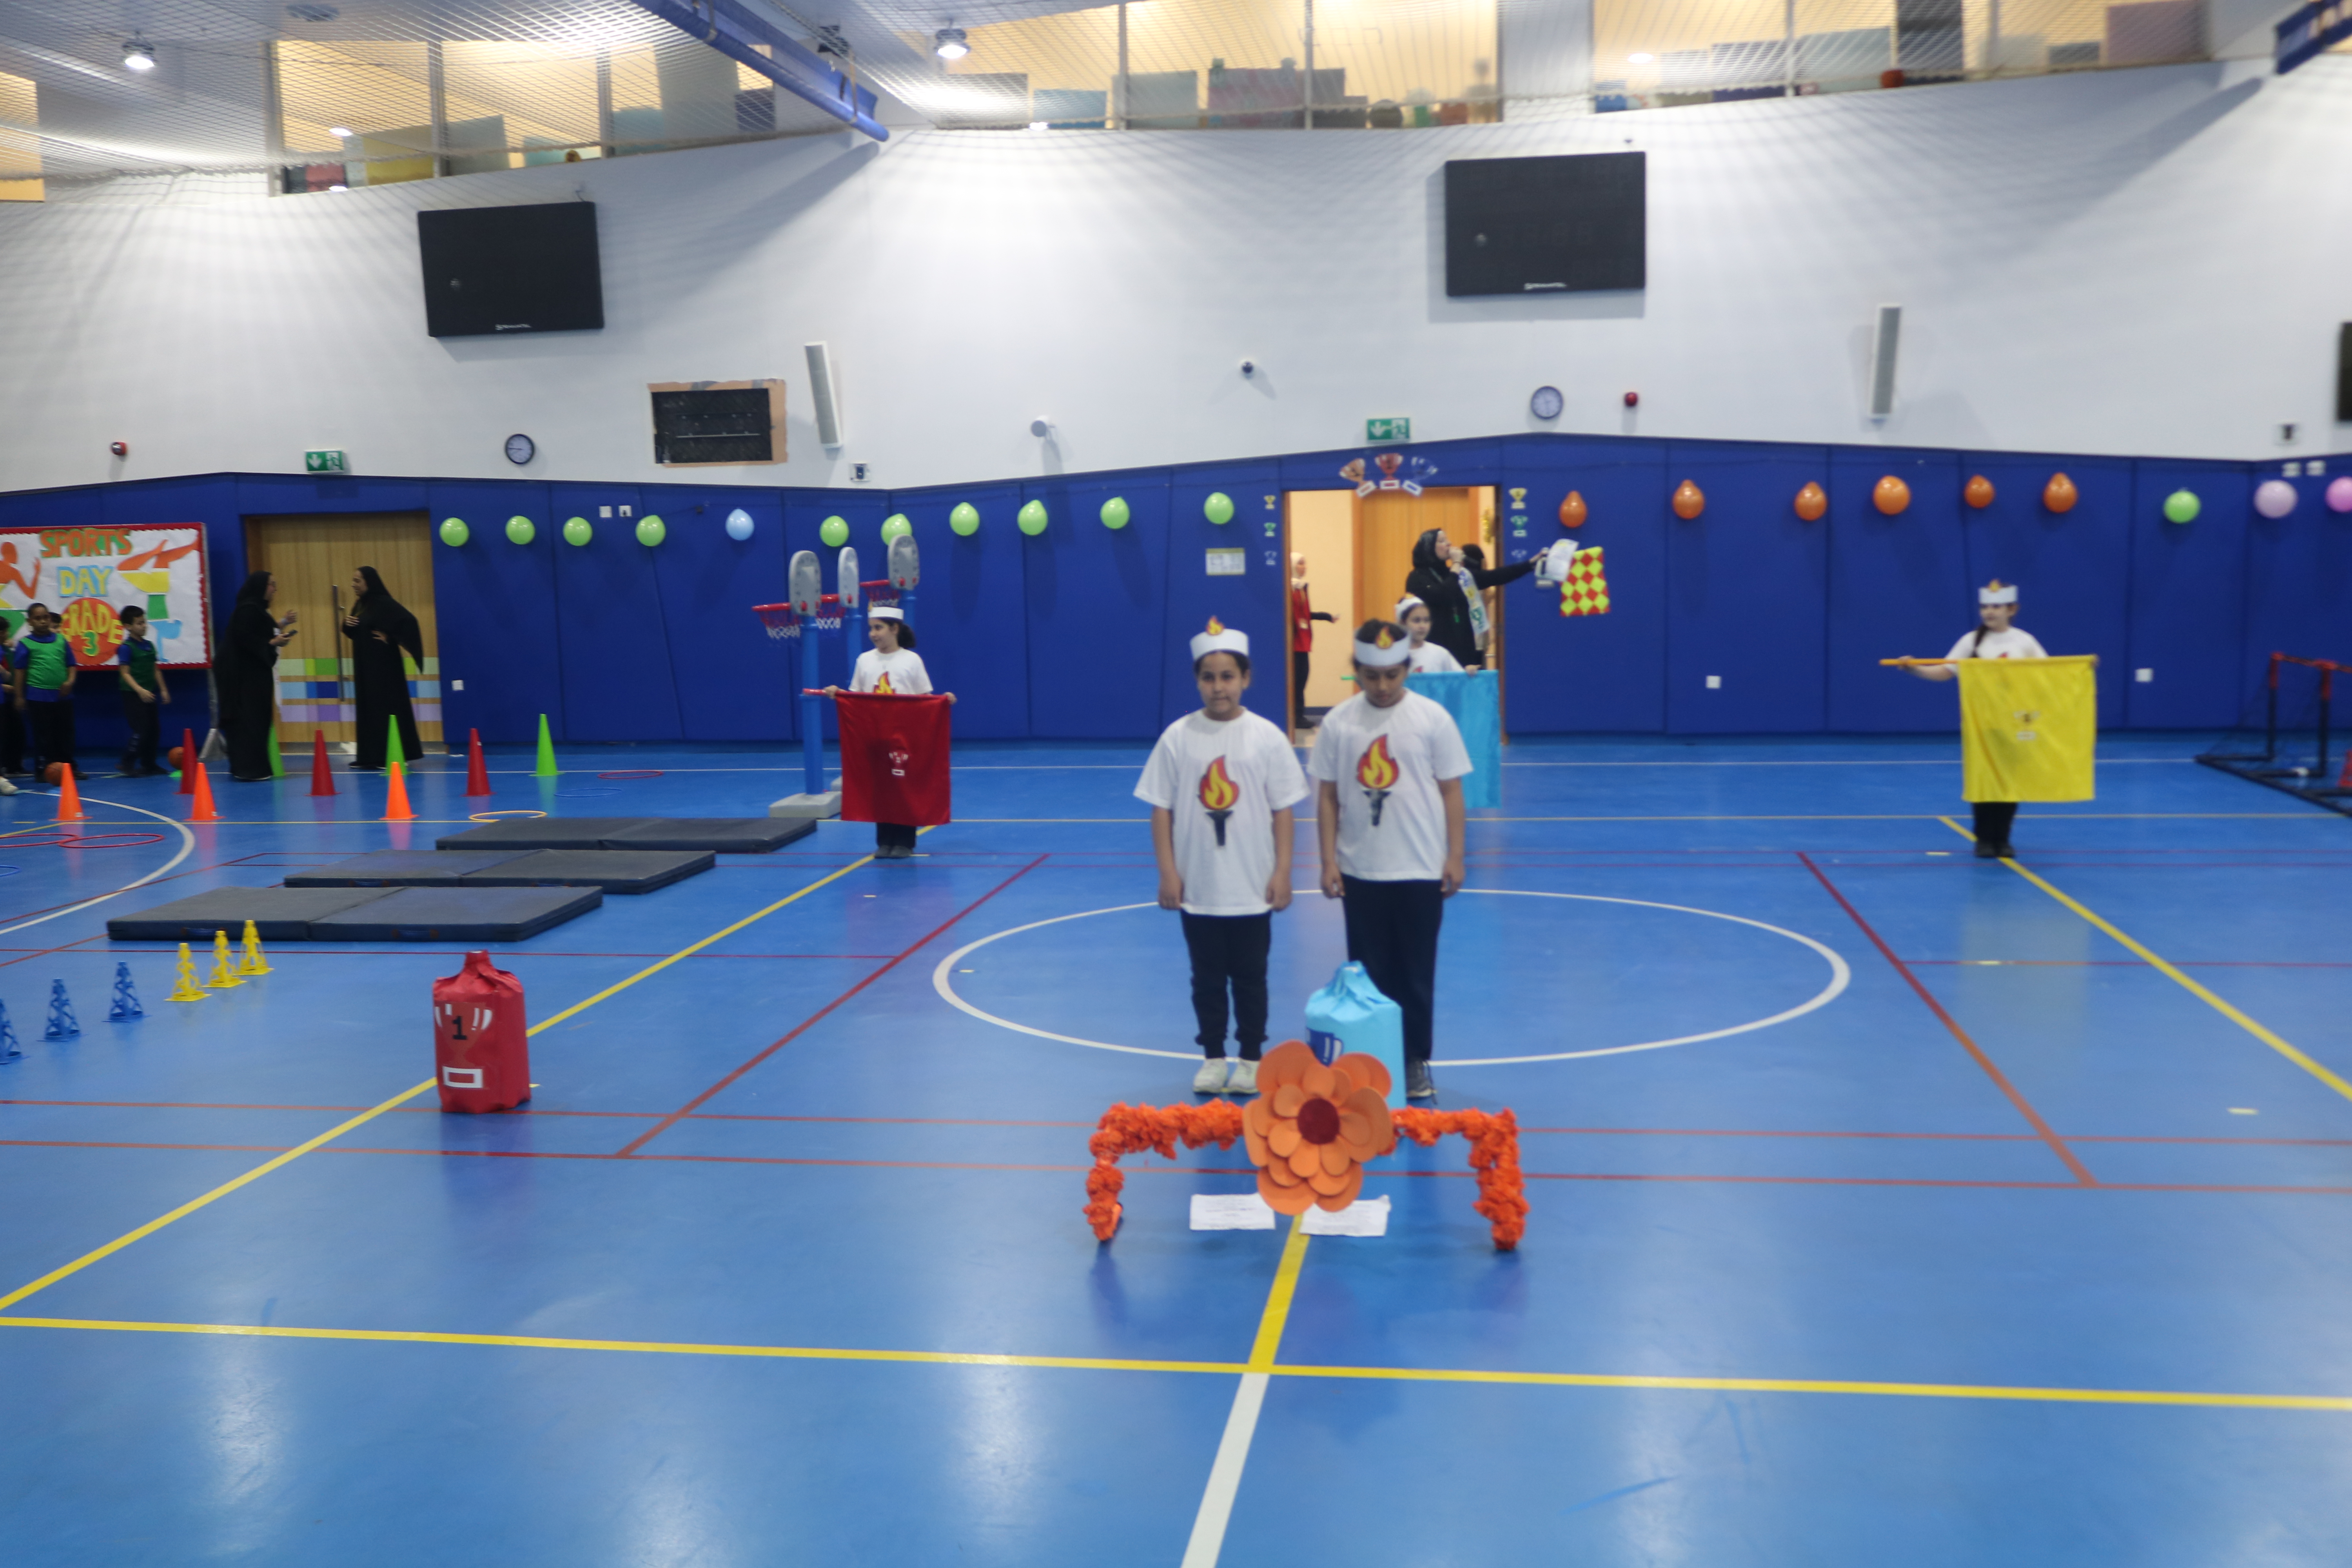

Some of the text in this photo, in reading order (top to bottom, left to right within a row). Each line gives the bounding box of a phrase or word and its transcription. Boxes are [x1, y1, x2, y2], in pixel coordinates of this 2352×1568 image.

[40, 528, 132, 558] SPORTS
[58, 565, 114, 597] DAY
[81, 630, 99, 657] 3
[452, 1016, 467, 1040] 1
